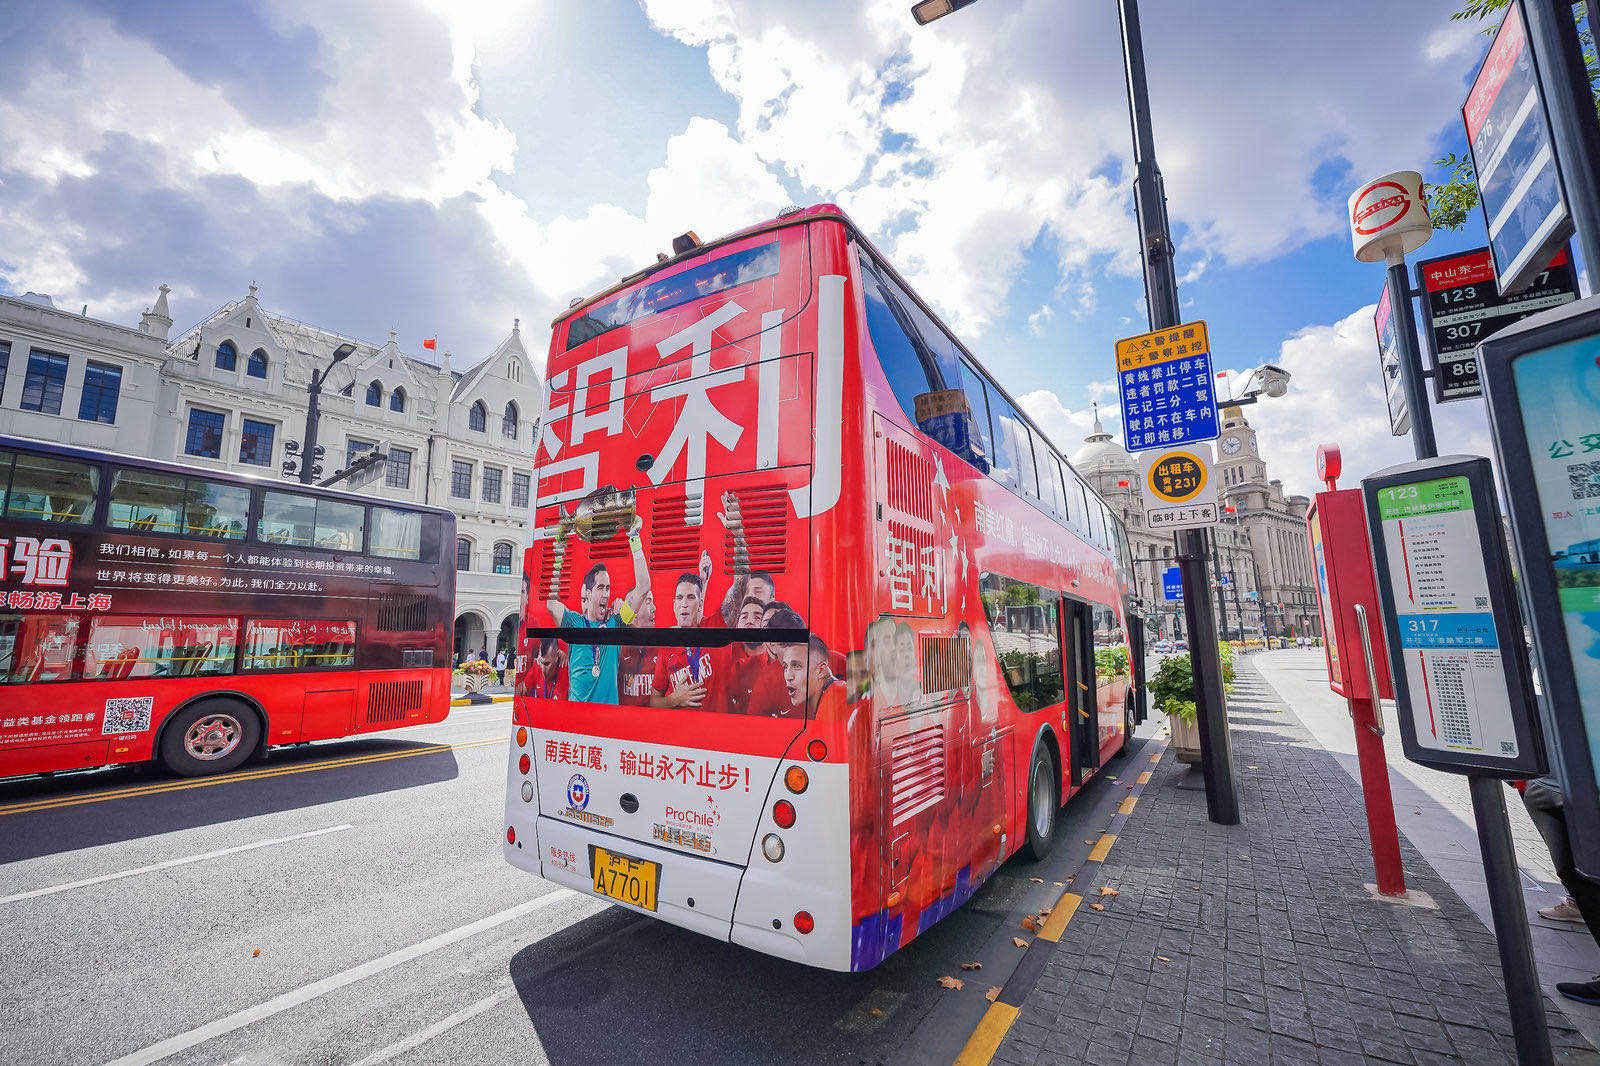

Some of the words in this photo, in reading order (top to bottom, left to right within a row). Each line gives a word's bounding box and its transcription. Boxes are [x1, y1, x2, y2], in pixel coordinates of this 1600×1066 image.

[1441, 287, 1477, 304] 123
[1140, 328, 1195, 350] 交警提醒
[1446, 322, 1482, 340] 307
[1121, 342, 1203, 367] 电子警察监控
[1124, 357, 1207, 386] 黄线禁止停车
[1126, 373, 1208, 401] 违者罚款二百
[535, 274, 848, 540] 智利
[1129, 406, 1212, 432] 驶员不在车内
[1158, 462, 1194, 477] 出租车
[1174, 476, 1196, 489] 231
[1388, 486, 1418, 501] 123
[1152, 508, 1211, 523] 临时上下客
[885, 530, 948, 615] 智利
[1408, 619, 1439, 632] 317
[0, 712, 96, 728] 益类基金领跑者
[665, 806, 714, 827] ProChile
[596, 866, 649, 906] A7701
